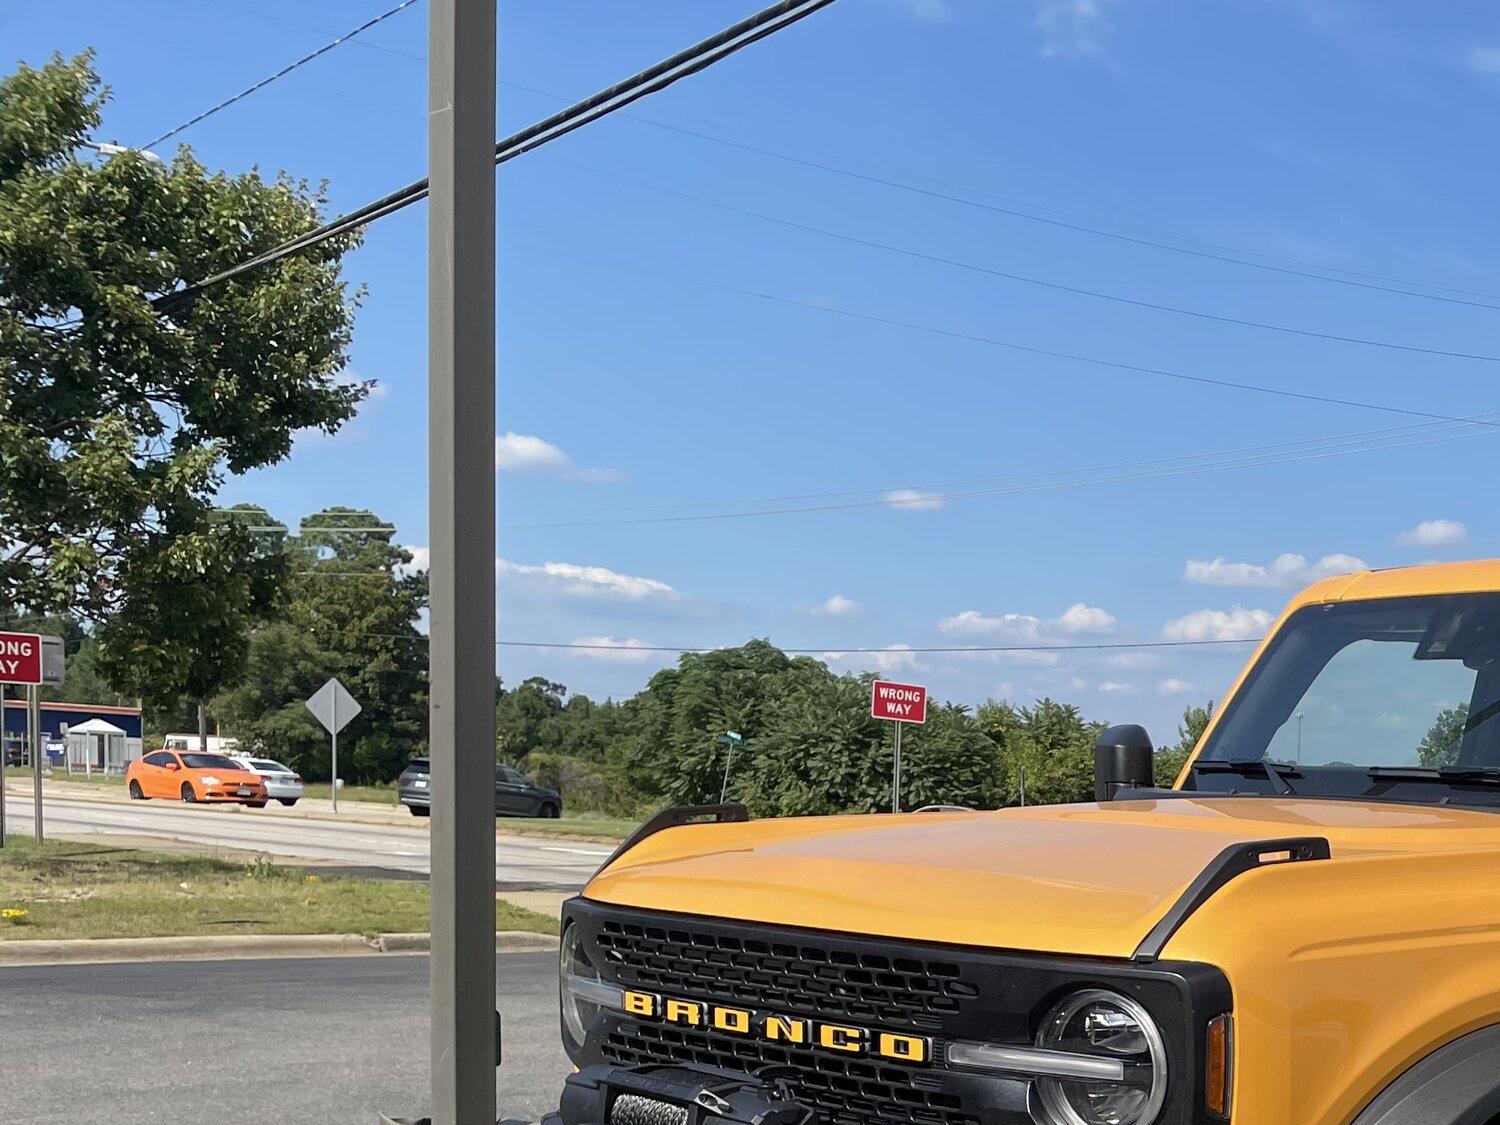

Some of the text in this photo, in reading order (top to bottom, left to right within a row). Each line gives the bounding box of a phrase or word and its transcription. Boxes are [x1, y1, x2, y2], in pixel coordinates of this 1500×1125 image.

[879, 687, 921, 703] WRONG
[886, 701, 912, 716] WAY
[624, 990, 926, 1062] BRONCO
